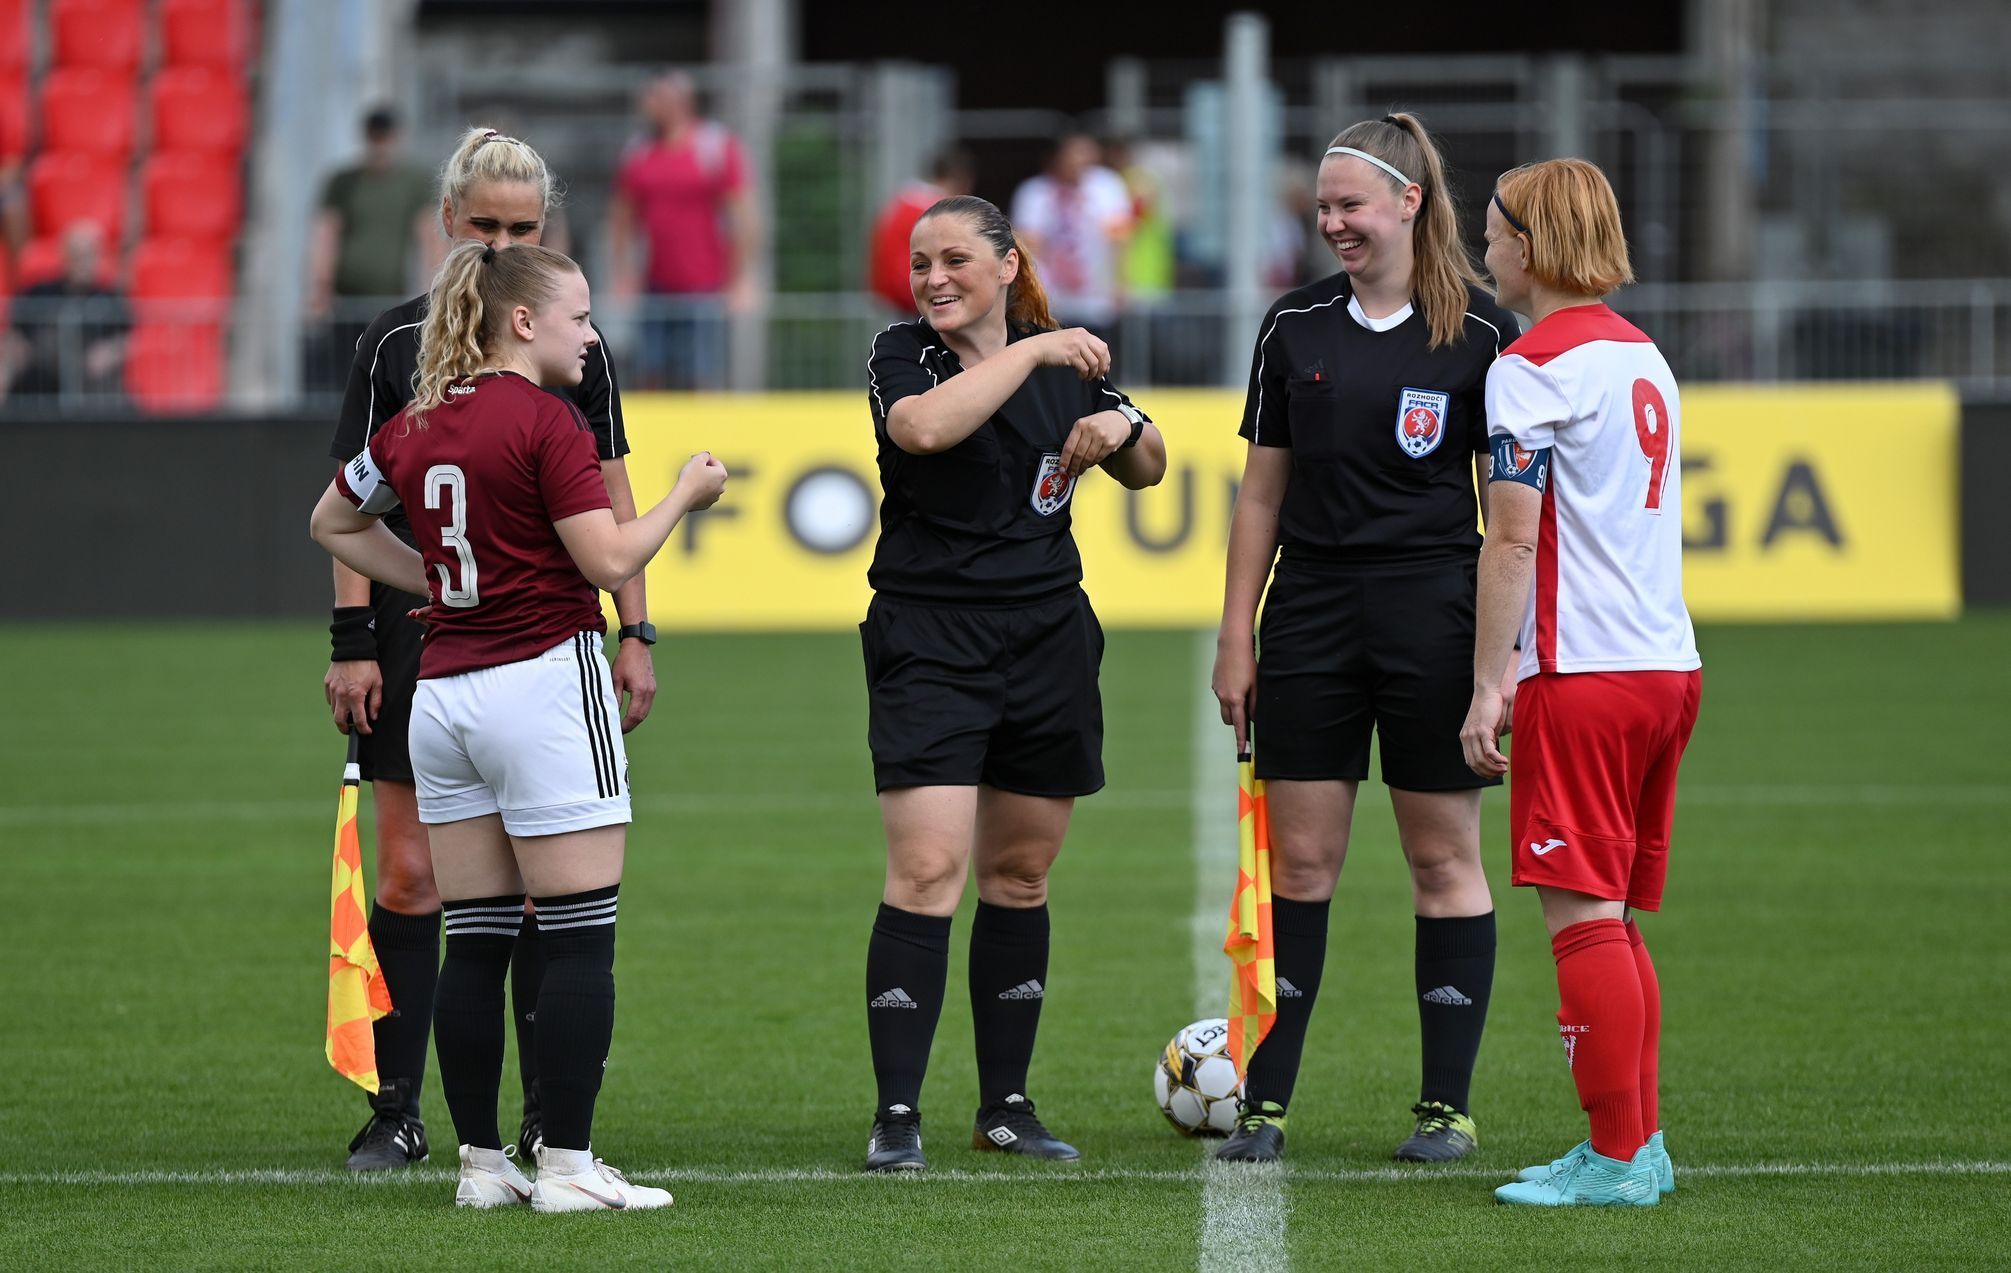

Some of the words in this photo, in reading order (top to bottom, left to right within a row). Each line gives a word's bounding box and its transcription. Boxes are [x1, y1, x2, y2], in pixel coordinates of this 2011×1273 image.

[1631, 377, 1674, 515] 9
[1536, 464, 1546, 489] 9
[424, 464, 480, 609] 3
[870, 998, 918, 1010] adidas
[1423, 993, 1473, 1006] adidas
